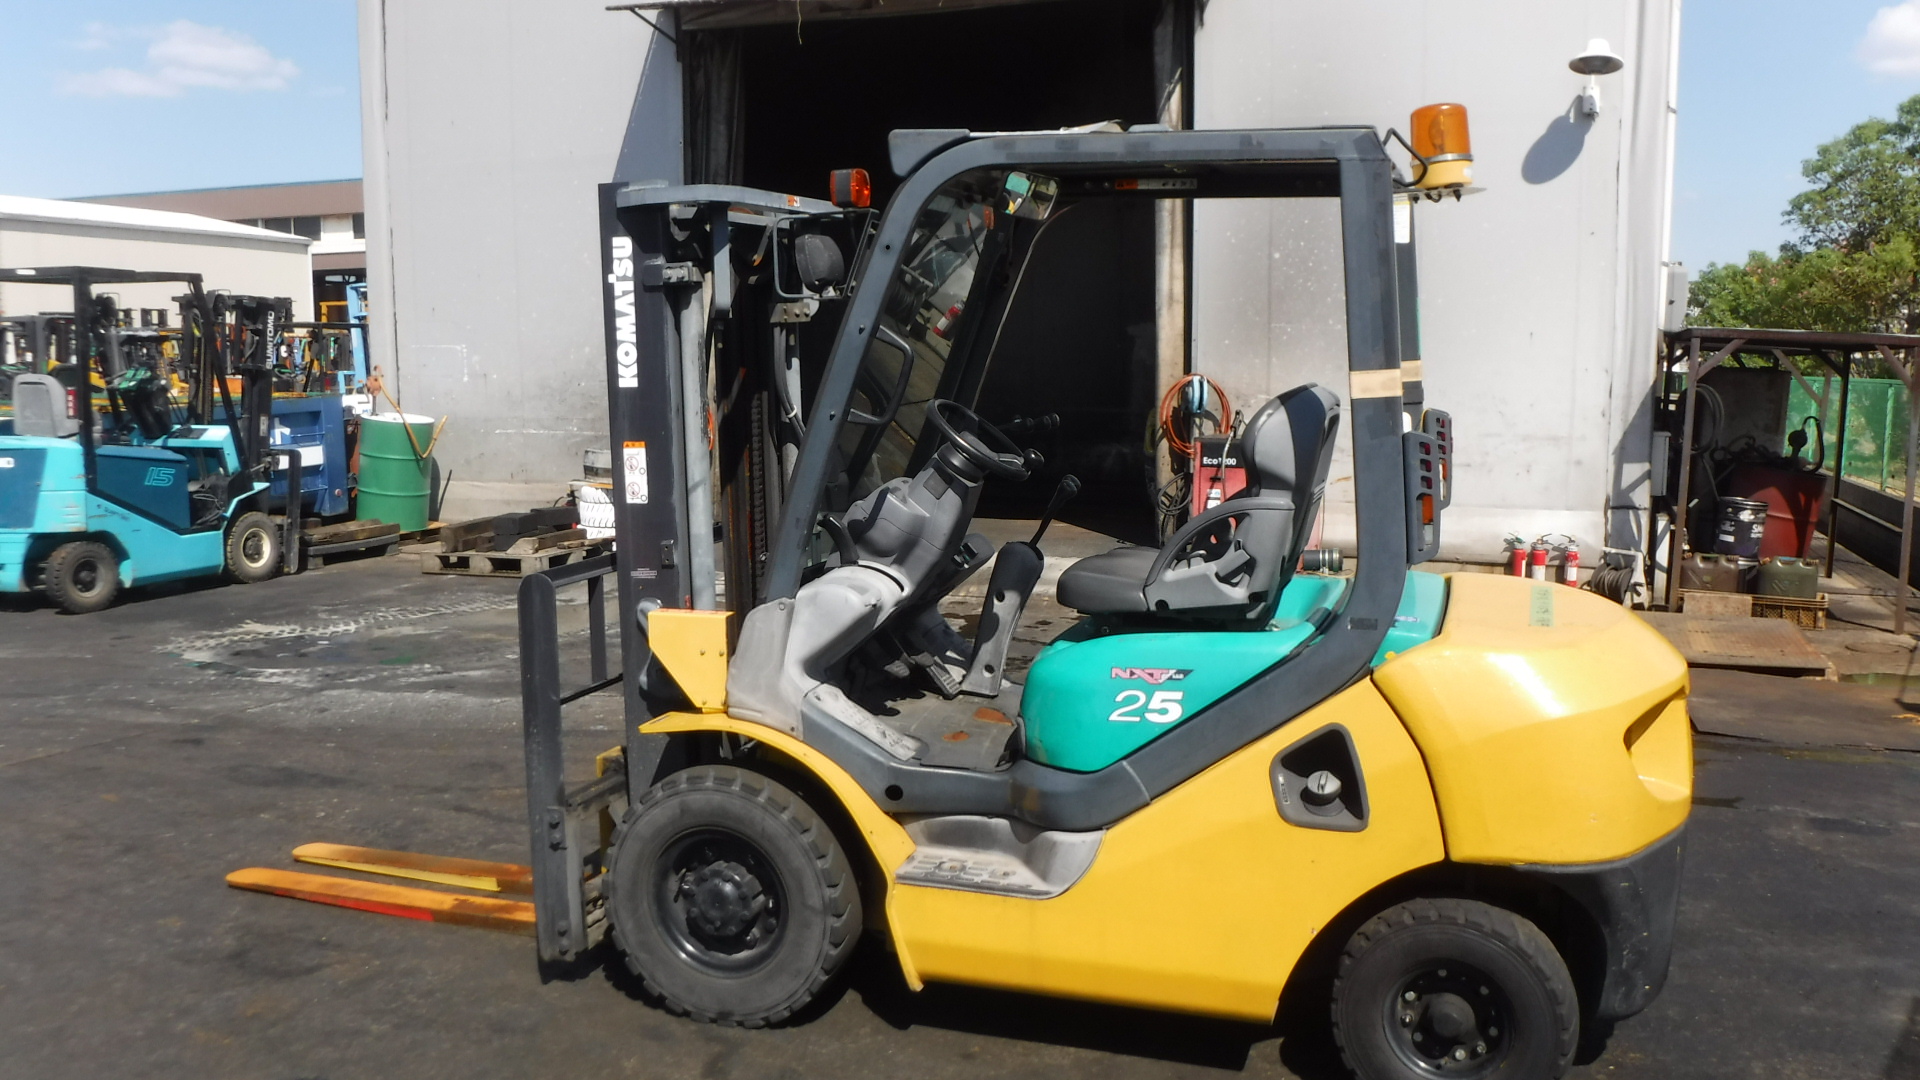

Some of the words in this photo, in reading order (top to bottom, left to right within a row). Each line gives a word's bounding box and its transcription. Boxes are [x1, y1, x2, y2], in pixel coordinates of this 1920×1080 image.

[608, 236, 638, 388] KOMATSU
[266, 310, 275, 369] SUMITOMO
[144, 466, 175, 487] 15
[1202, 456, 1237, 466] Eco100
[1108, 689, 1184, 723] 25
